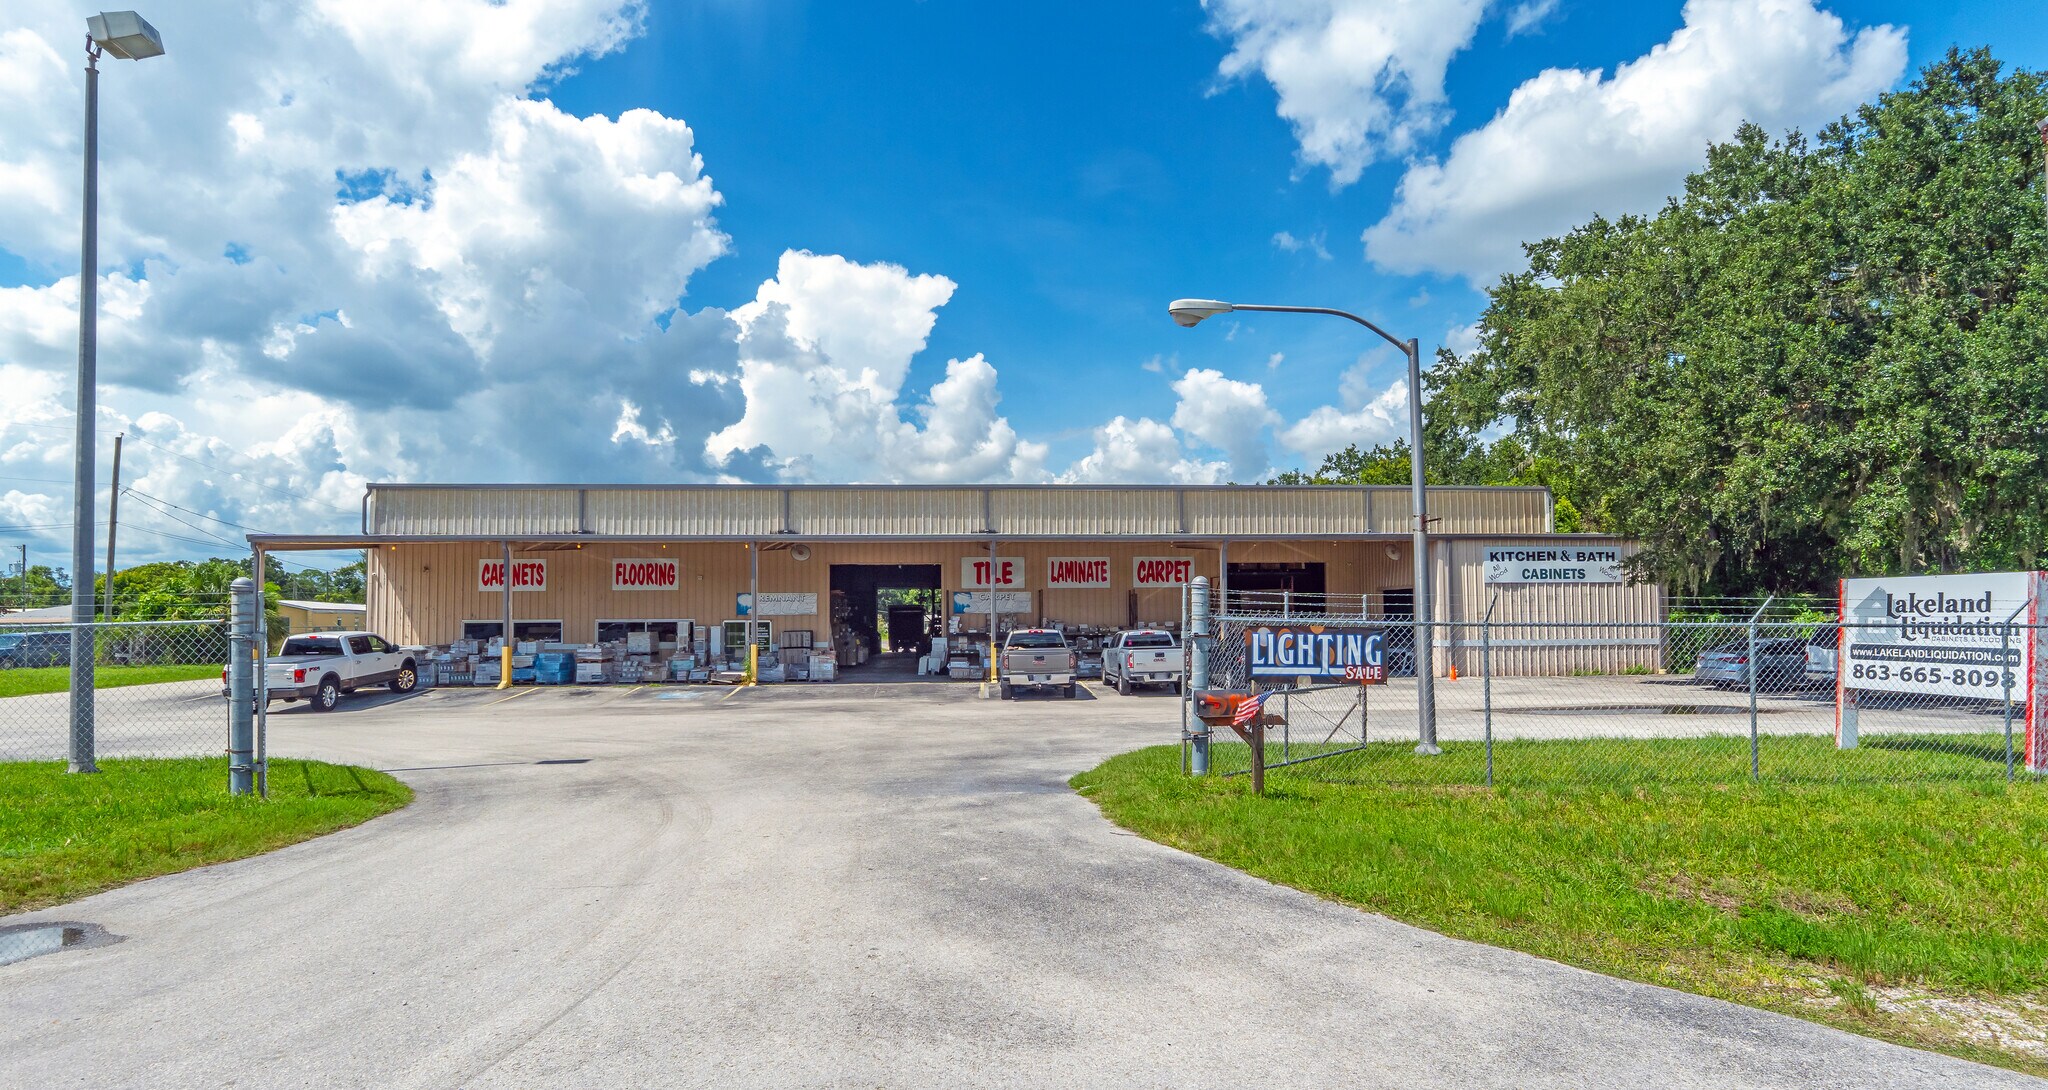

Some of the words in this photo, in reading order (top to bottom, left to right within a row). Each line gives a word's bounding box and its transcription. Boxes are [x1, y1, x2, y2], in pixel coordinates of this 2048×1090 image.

[1489, 551, 1557, 562] KITCHEN
[1560, 549, 1572, 562] &
[1576, 551, 1616, 562] BATH
[481, 562, 545, 587] CABNETS
[615, 562, 676, 587] FLOORING
[973, 561, 1013, 585] TILE
[1050, 560, 1108, 584] LAMINATE
[1137, 559, 1192, 584] CARPET
[1488, 566, 1509, 581] Wood
[1521, 568, 1586, 580] CABINETS
[1599, 566, 1618, 580] Wood
[758, 593, 806, 602] REMNANT
[1886, 591, 1992, 619] Lakeland
[1901, 615, 2022, 642] Liquidation
[1252, 633, 1382, 675] LIGHTING
[1345, 666, 1382, 680] SALE
[1852, 663, 2017, 689] 863-665-8098
